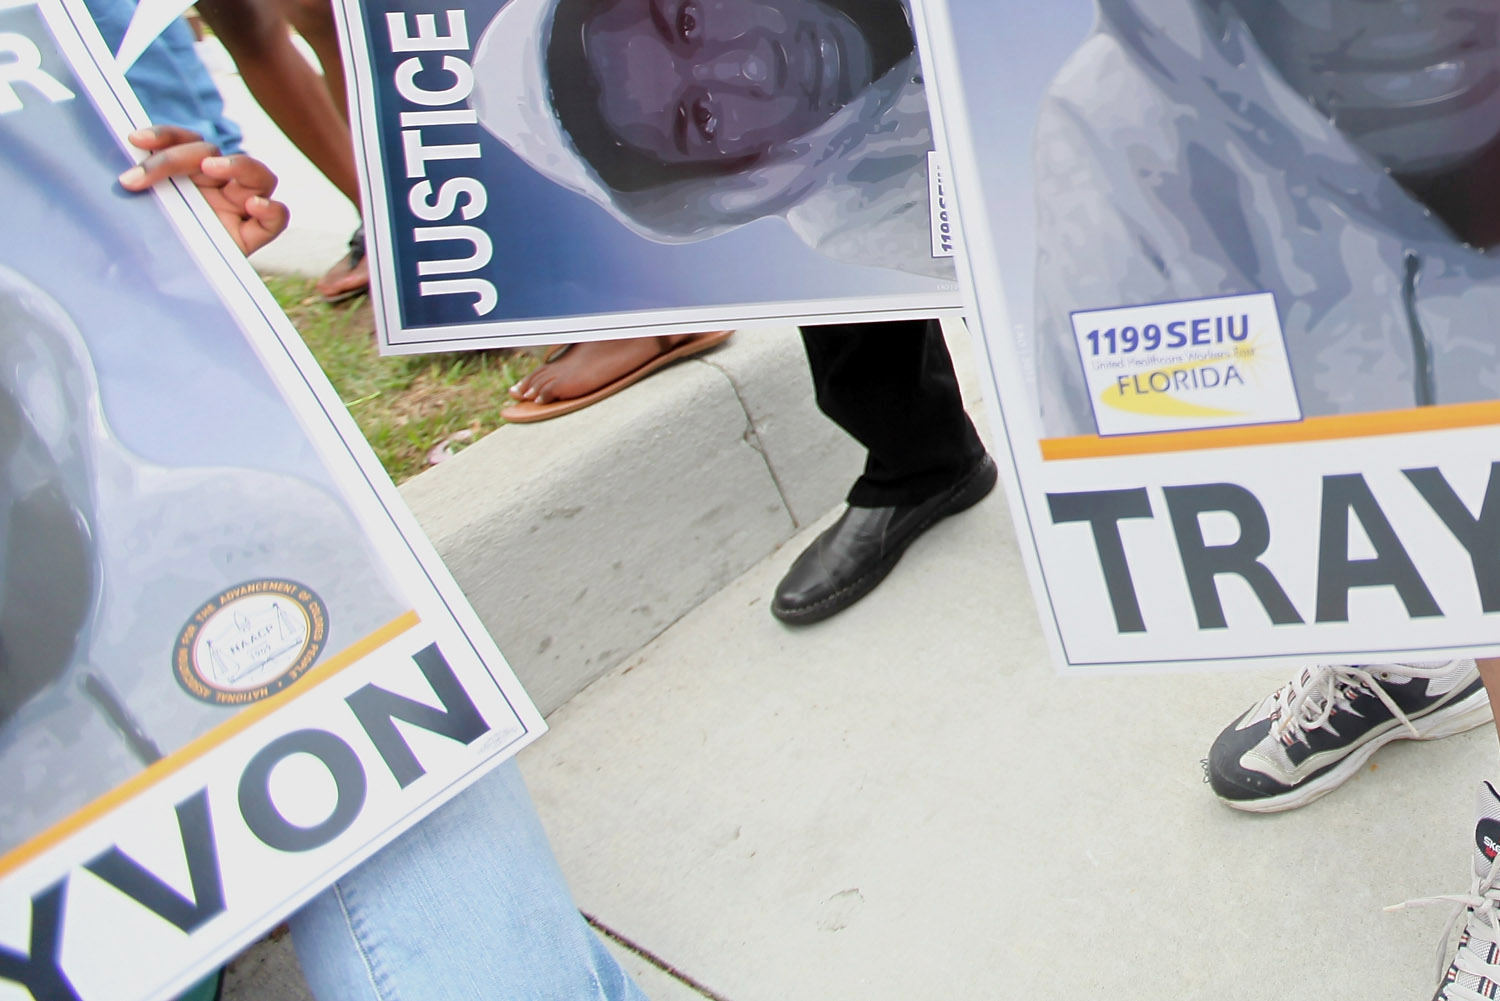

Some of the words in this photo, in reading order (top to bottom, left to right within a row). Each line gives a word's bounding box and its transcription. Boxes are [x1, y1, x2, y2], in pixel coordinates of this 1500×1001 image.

[386, 9, 498, 317] JUSTICE
[1087, 314, 1249, 356] 1199SEIU
[1117, 365, 1245, 396] FLORIDA
